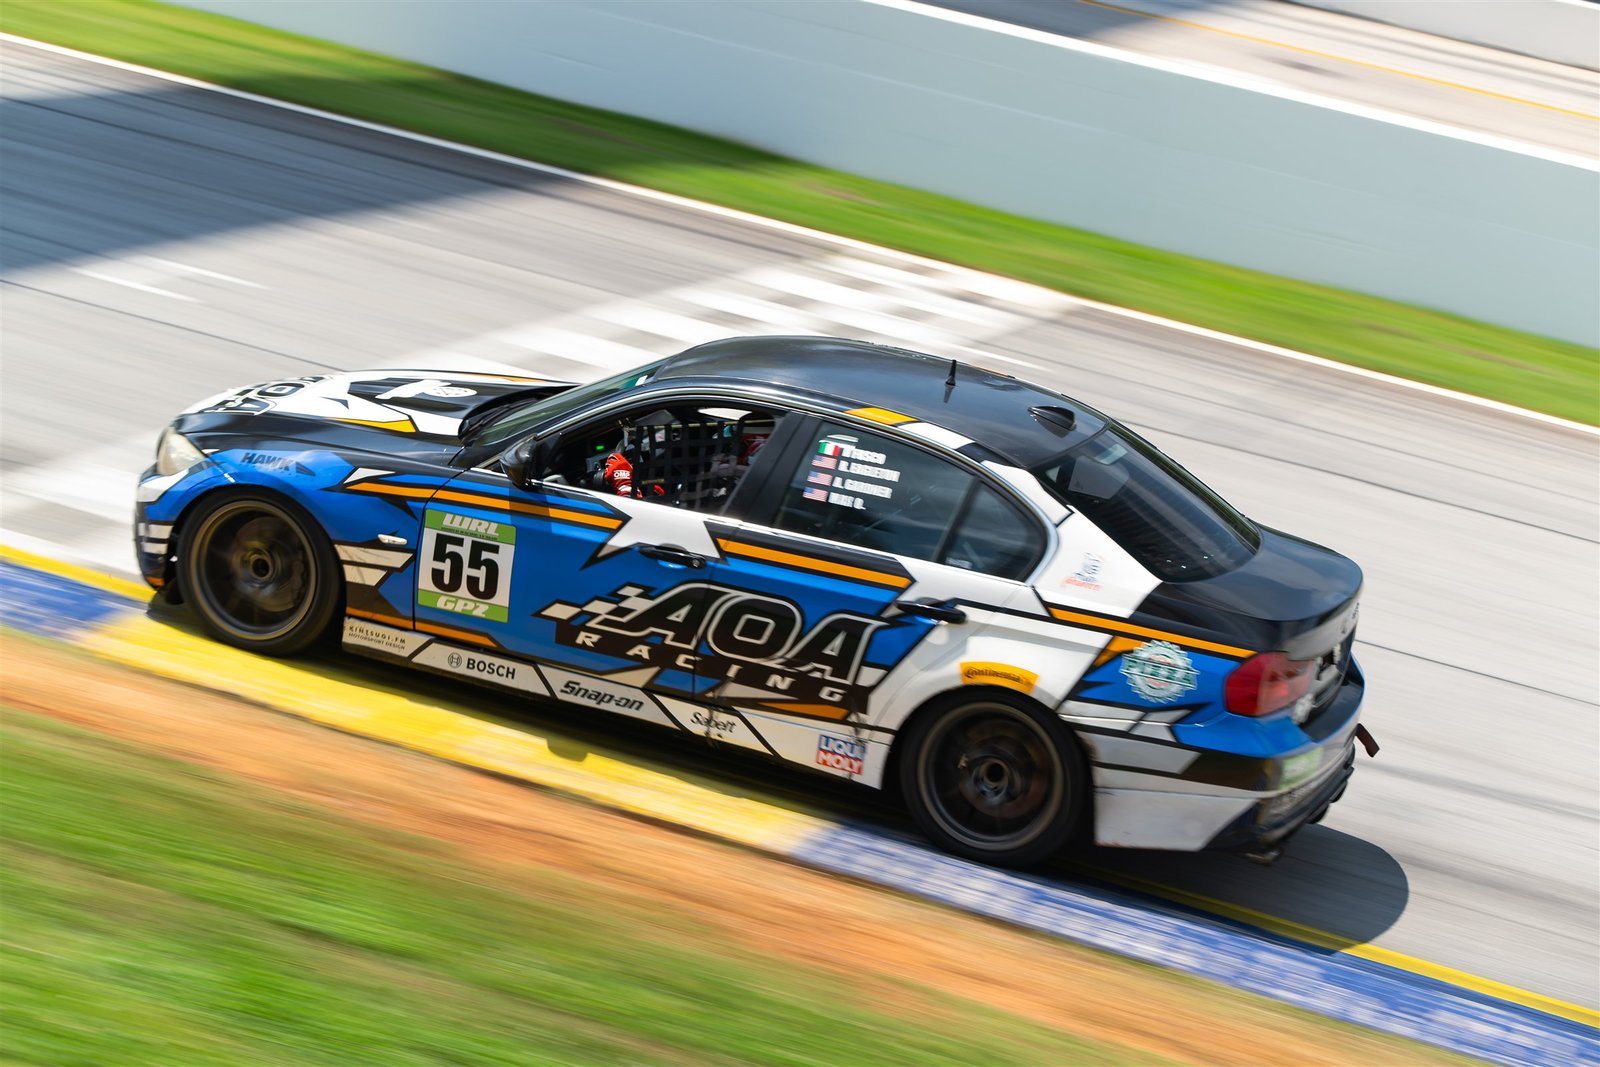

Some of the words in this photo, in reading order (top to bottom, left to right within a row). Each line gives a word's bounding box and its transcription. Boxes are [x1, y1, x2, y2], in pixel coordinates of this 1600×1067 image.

[241, 452, 294, 471] HAWK
[613, 470, 631, 480] OMP
[442, 513, 499, 536] WRL
[431, 533, 500, 600] 55
[586, 583, 889, 686] AOA
[466, 657, 516, 680] BOSCH
[575, 630, 847, 702] RACING
[560, 680, 645, 712] Snap-on
[817, 750, 863, 775] MOLY
